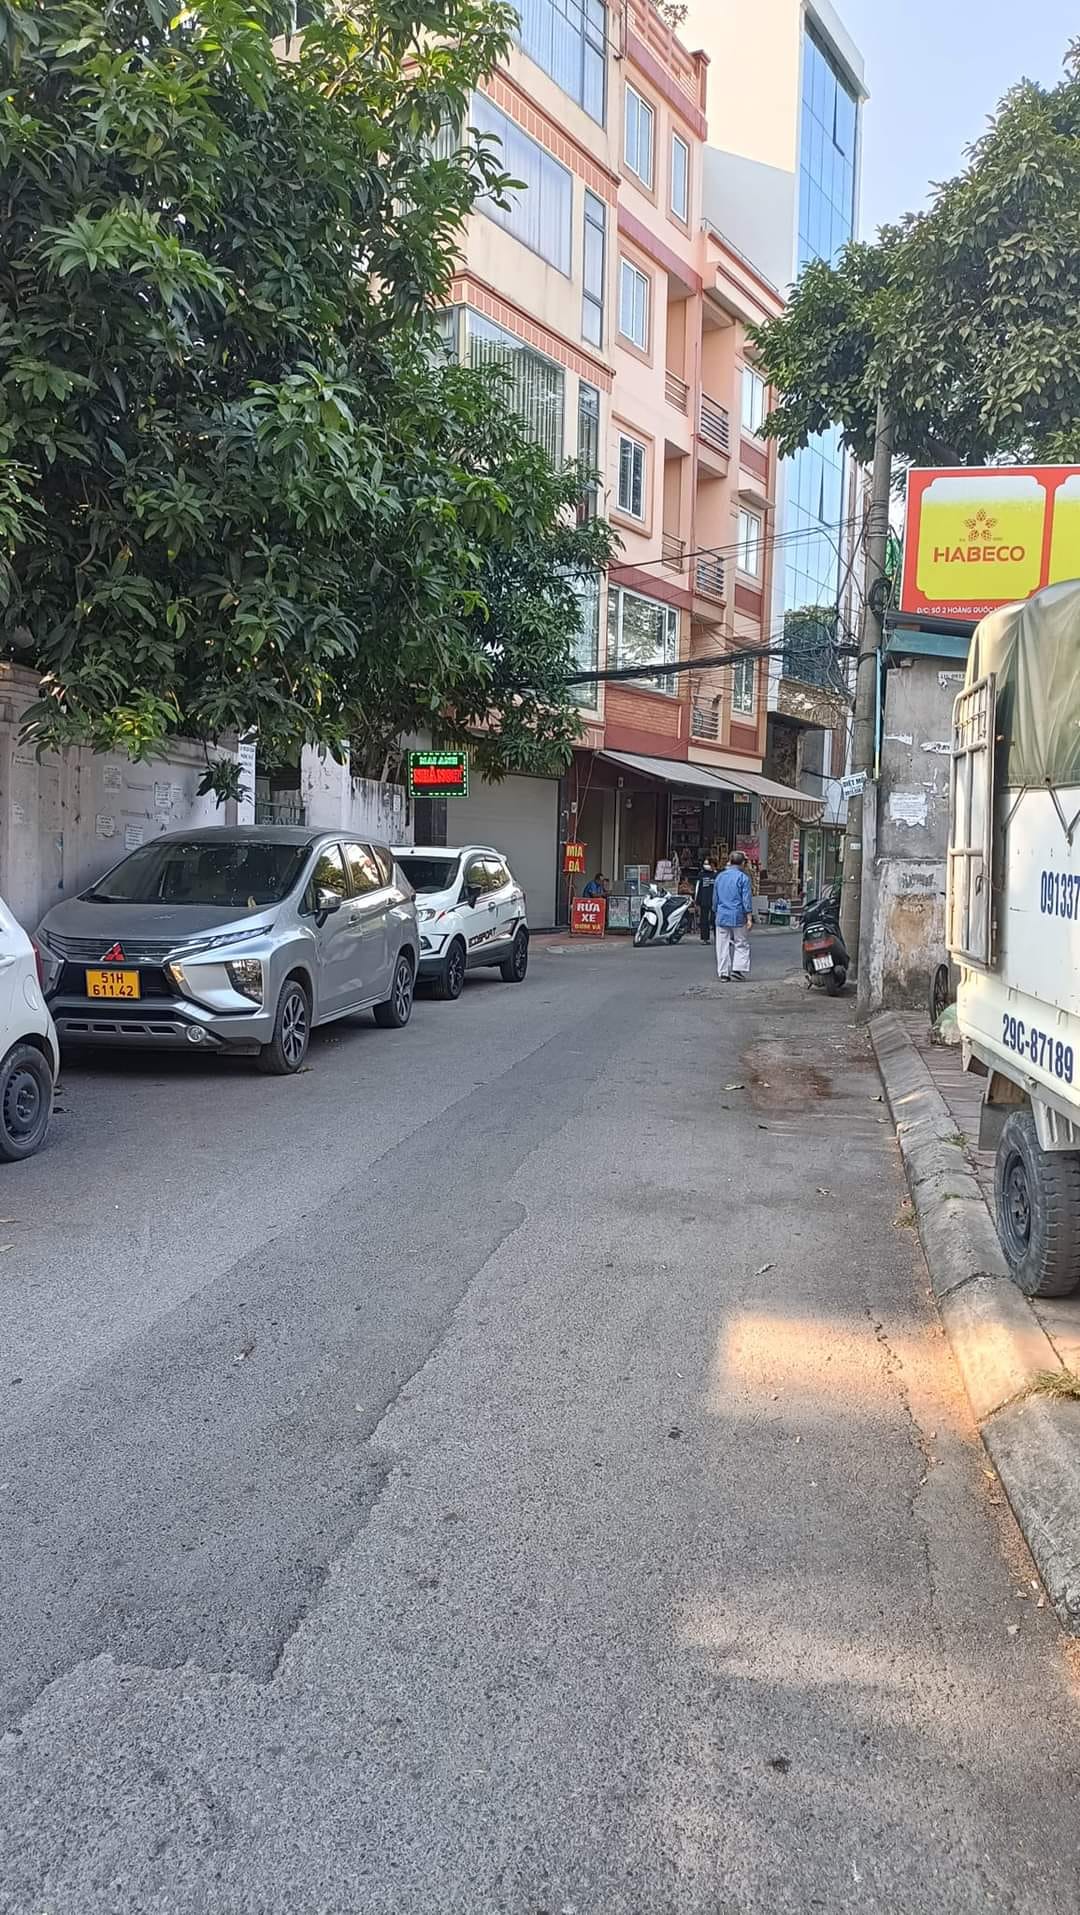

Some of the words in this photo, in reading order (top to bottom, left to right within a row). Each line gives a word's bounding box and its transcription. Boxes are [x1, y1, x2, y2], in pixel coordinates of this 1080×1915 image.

[933, 546, 1025, 563] HABECO
[576, 900, 600, 912] RỬA
[581, 913, 597, 922] XE
[101, 972, 124, 984] 51H
[93, 984, 134, 996] 611.42
[1002, 1012, 1074, 1084] 29C-87189
